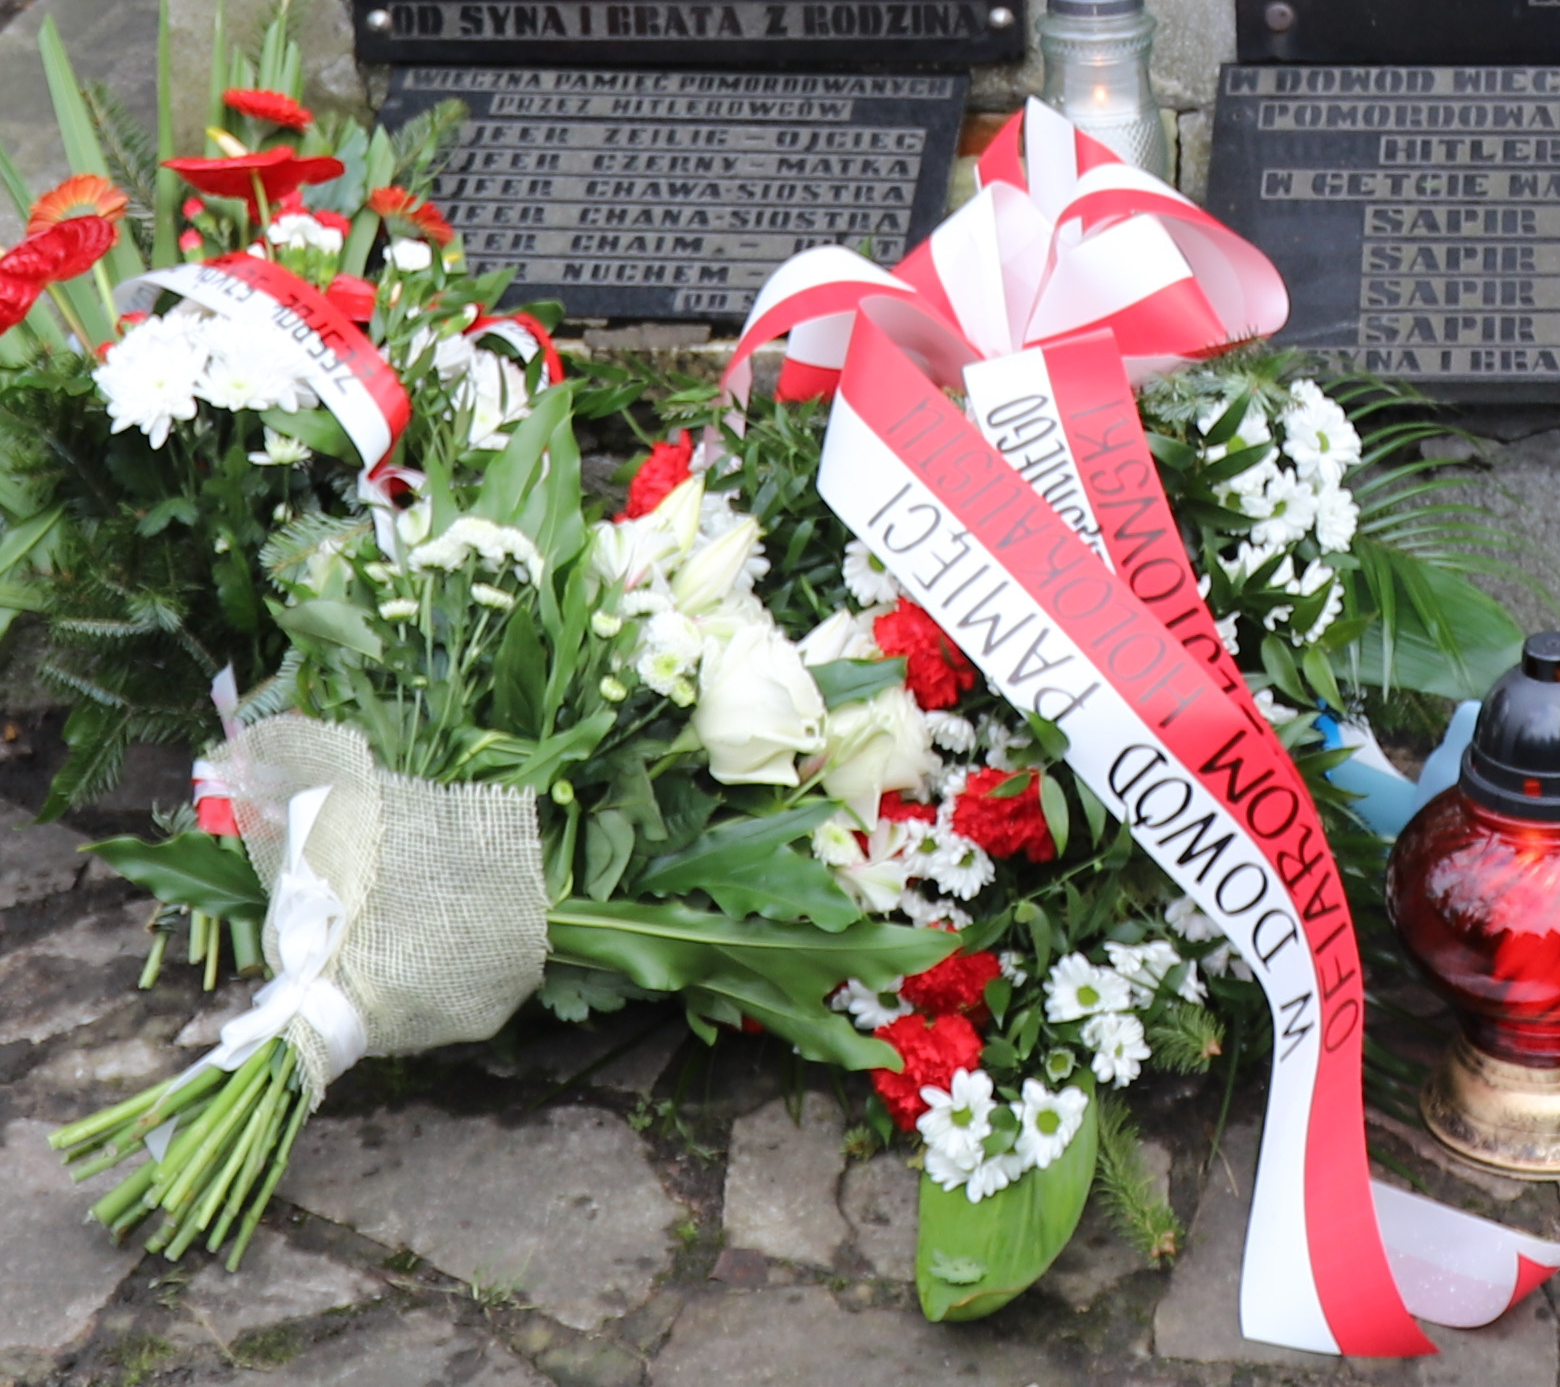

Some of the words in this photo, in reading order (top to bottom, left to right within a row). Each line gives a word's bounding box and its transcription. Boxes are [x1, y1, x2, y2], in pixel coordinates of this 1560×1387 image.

[392, 4, 442, 38] OD
[458, 4, 562, 38] SYNA
[579, 6, 593, 37] I
[606, 4, 740, 37] BRATA
[764, 4, 789, 37] Z
[409, 69, 541, 90] WIECZNA
[1227, 69, 1259, 94] W
[495, 95, 592, 115] PRZEZ
[775, 130, 924, 153] OJCIEC
[776, 158, 912, 178] MATKA
[1265, 172, 1294, 197] W
[1372, 208, 1538, 236] SAPIR
[1369, 245, 1537, 273] SAPIR
[561, 264, 731, 285] NUCHEM
[1367, 280, 1537, 307] SAPIR
[1365, 314, 1537, 343] SAPIR
[886, 394, 1207, 730] HOLOKAUSTU
[868, 482, 1102, 726] PAMIĘCI
[1107, 742, 1300, 974] DOWÓD
[1198, 728, 1360, 1054] OFIAROM
[1278, 989, 1317, 1064] W
